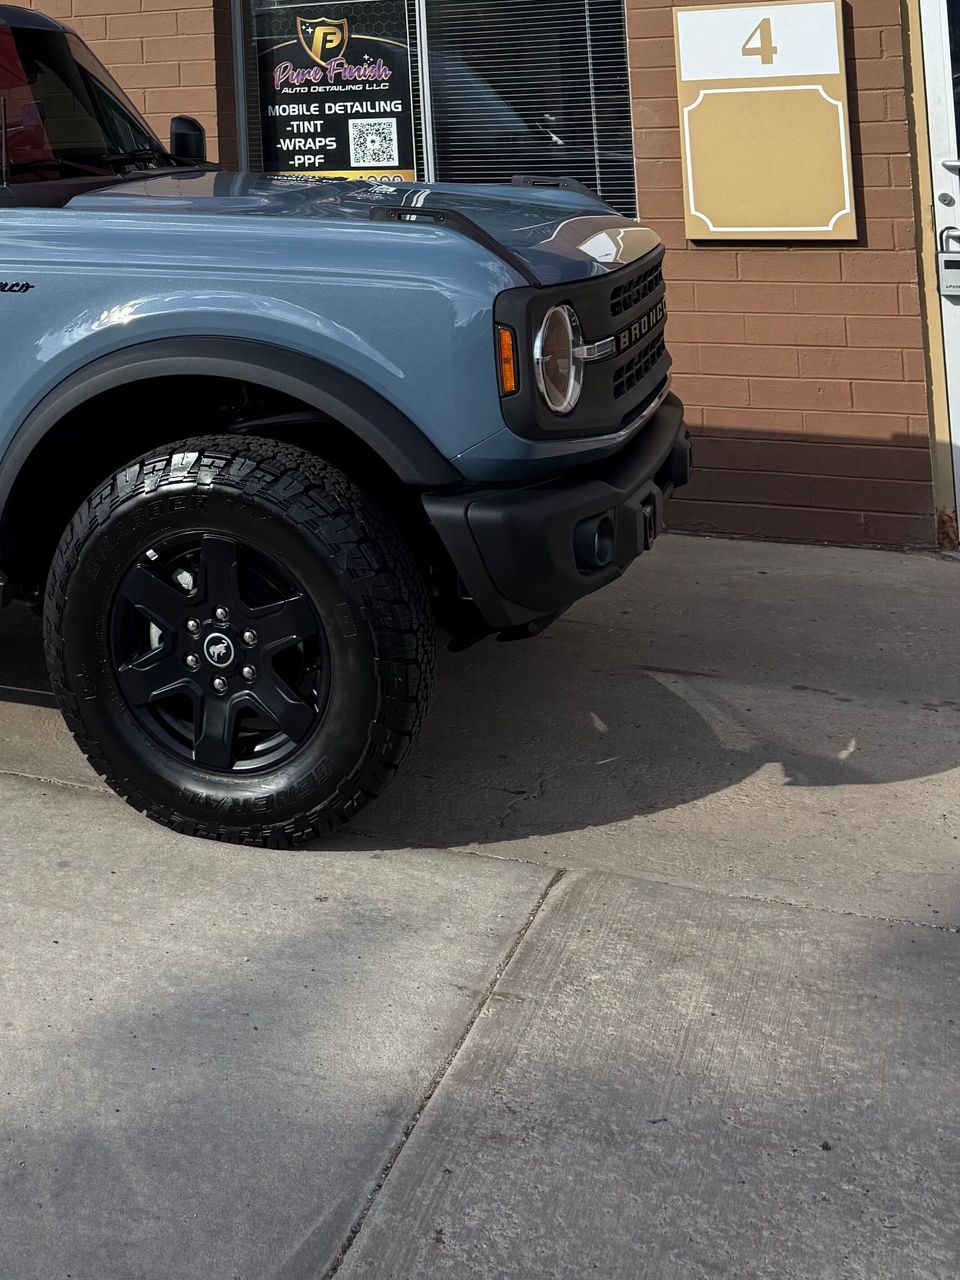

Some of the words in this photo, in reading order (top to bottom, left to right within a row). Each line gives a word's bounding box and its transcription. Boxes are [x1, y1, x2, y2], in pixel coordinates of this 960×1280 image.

[740, 17, 778, 65] 4
[273, 61, 323, 90] Pure
[324, 56, 392, 83] Finish
[281, 86, 309, 94] AUTO
[310, 84, 363, 93] DETAILING
[365, 82, 390, 91] LLC
[268, 102, 320, 117] MOBILE
[324, 100, 403, 115] DETAILING
[286, 120, 324, 134] -TINT
[276, 137, 337, 151] -WRAPS
[288, 154, 325, 168] -PPF
